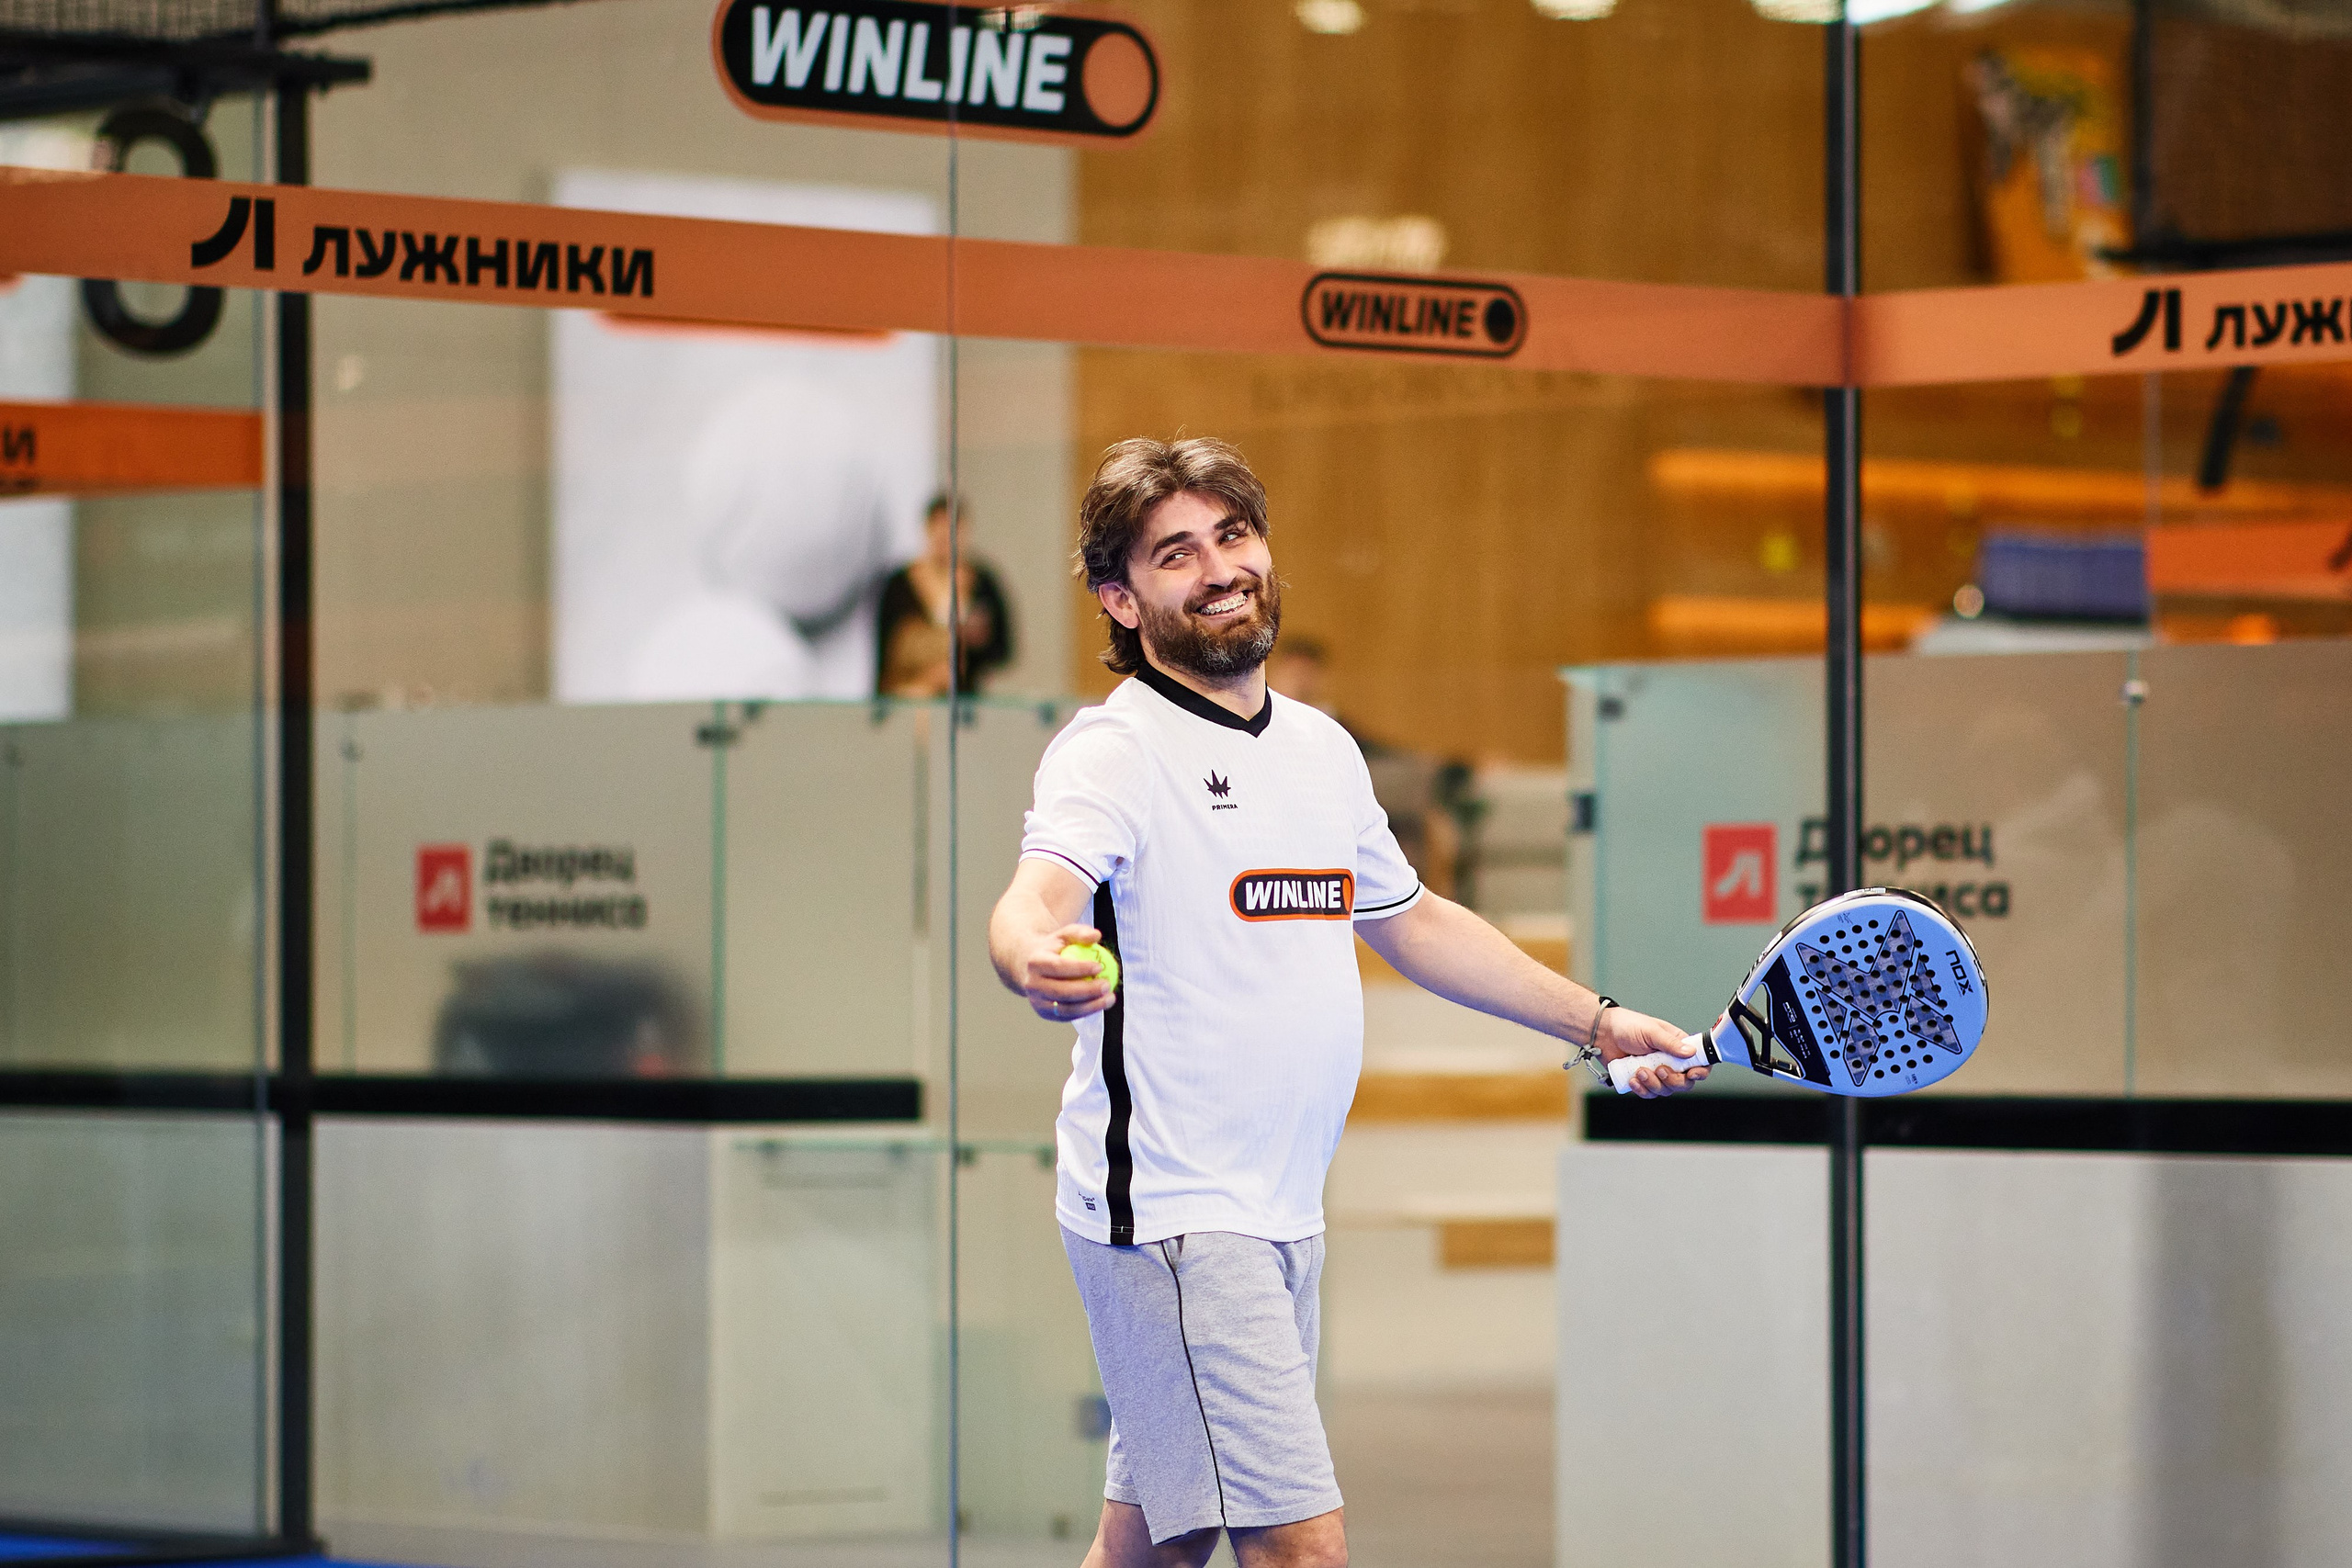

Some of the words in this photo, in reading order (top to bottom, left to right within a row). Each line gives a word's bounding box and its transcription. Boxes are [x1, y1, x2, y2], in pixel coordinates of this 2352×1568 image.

[751, 5, 1073, 113] WINLINE
[303, 225, 654, 298] ЛУЖНИКИ
[1319, 289, 1478, 339] WINLINE
[2207, 298, 2352, 350] ЛУЖ
[1794, 817, 1994, 870] Дорец
[1246, 880, 1341, 910] WINLINE
